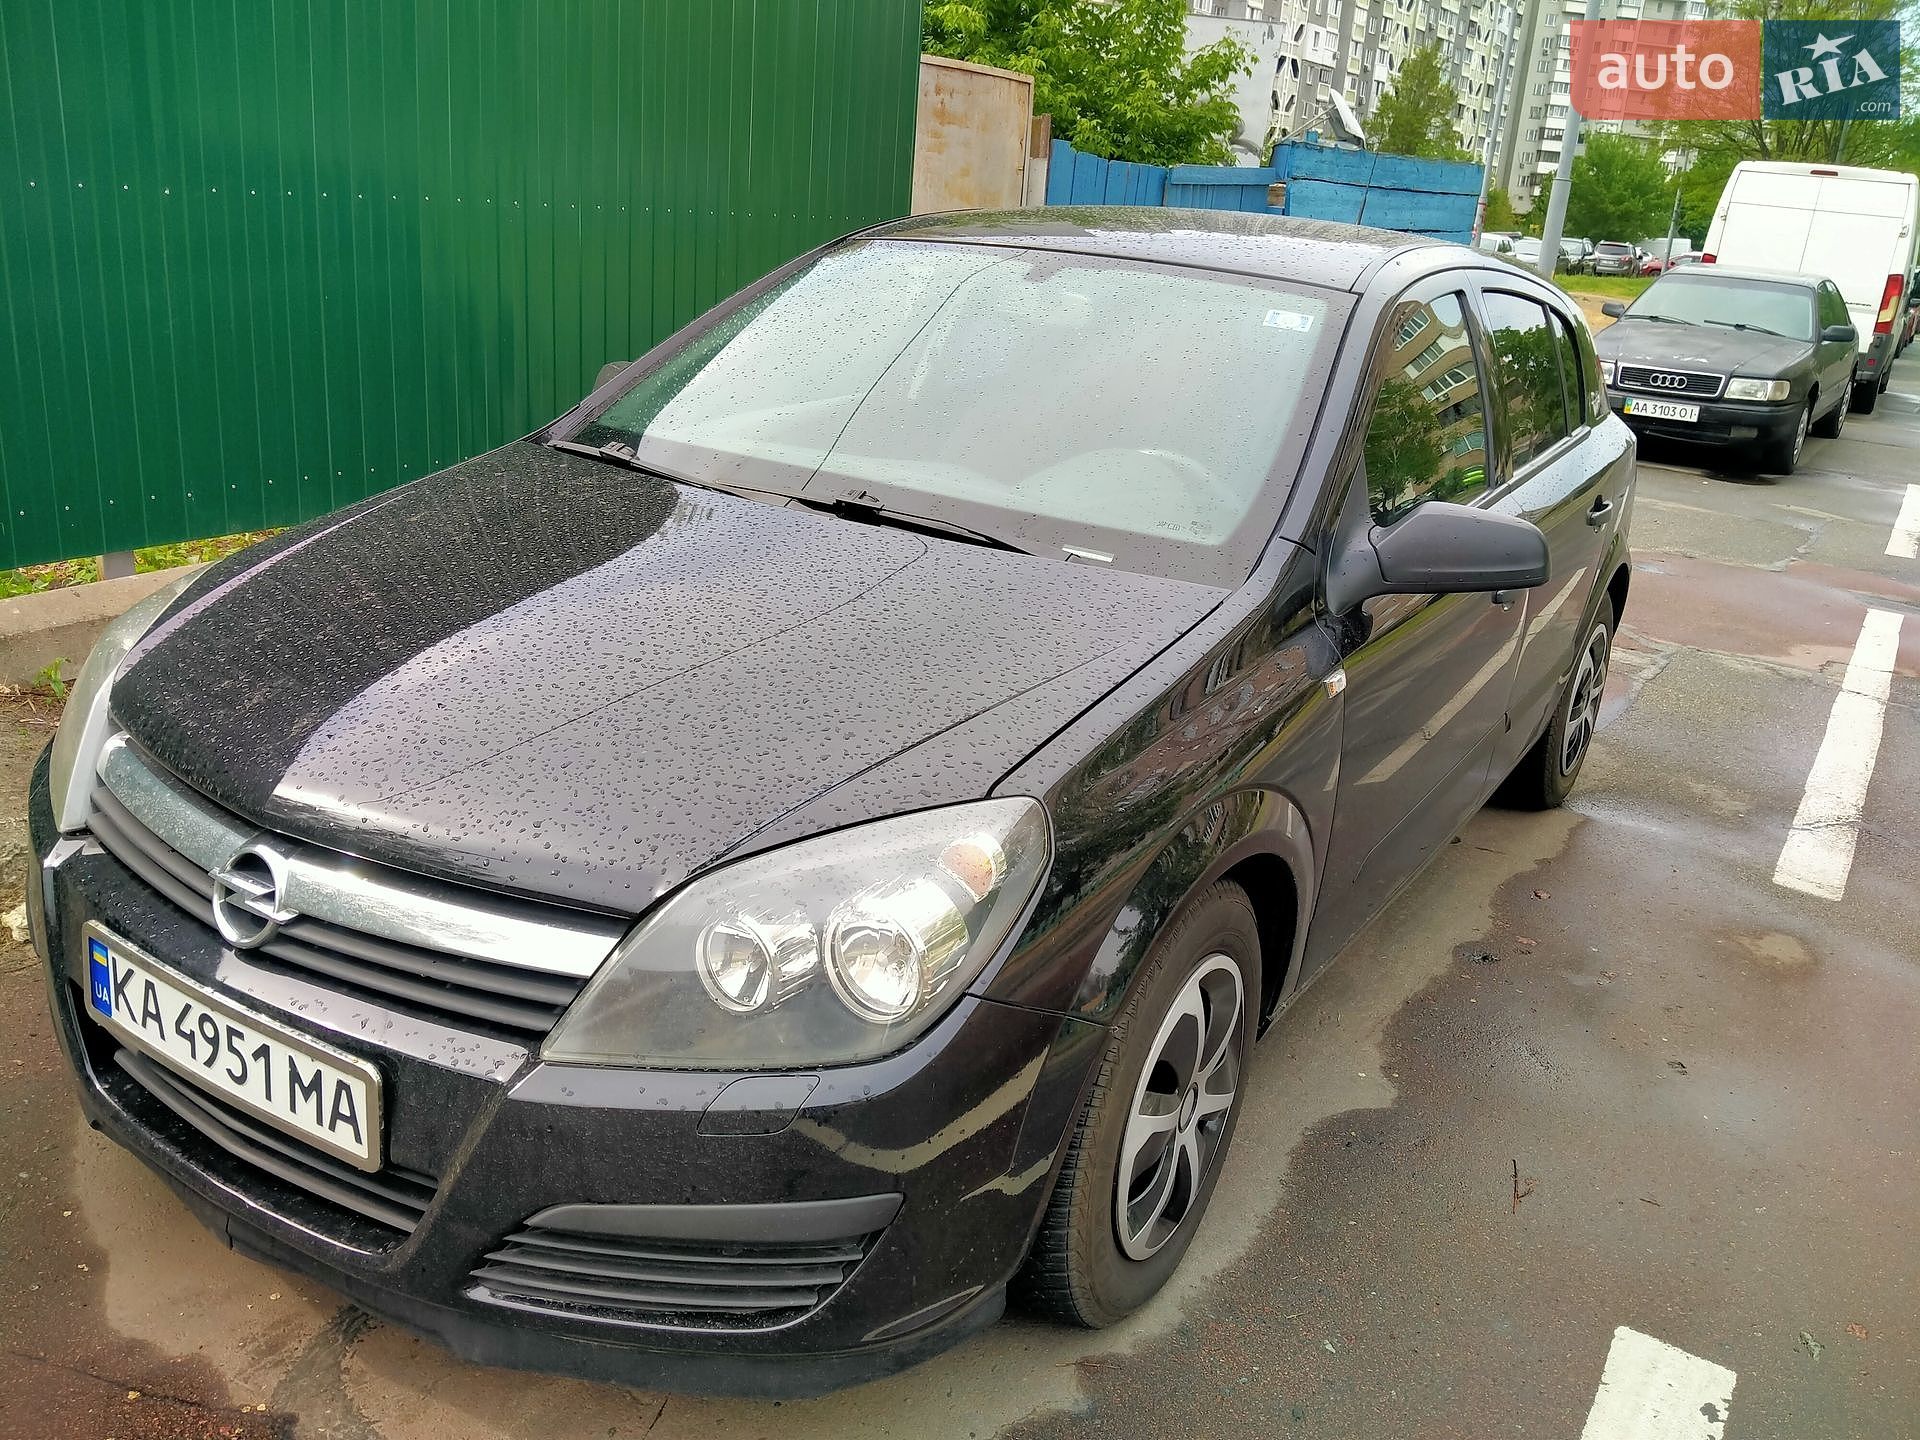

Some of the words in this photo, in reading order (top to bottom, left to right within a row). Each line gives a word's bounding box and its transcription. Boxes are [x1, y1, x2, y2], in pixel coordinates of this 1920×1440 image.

[1632, 402, 1648, 414] AA
[1650, 404, 1677, 417] 3103
[95, 980, 110, 1005] UA
[112, 955, 167, 1042] KA
[174, 1002, 272, 1103] 4951
[288, 1054, 363, 1146] MA
